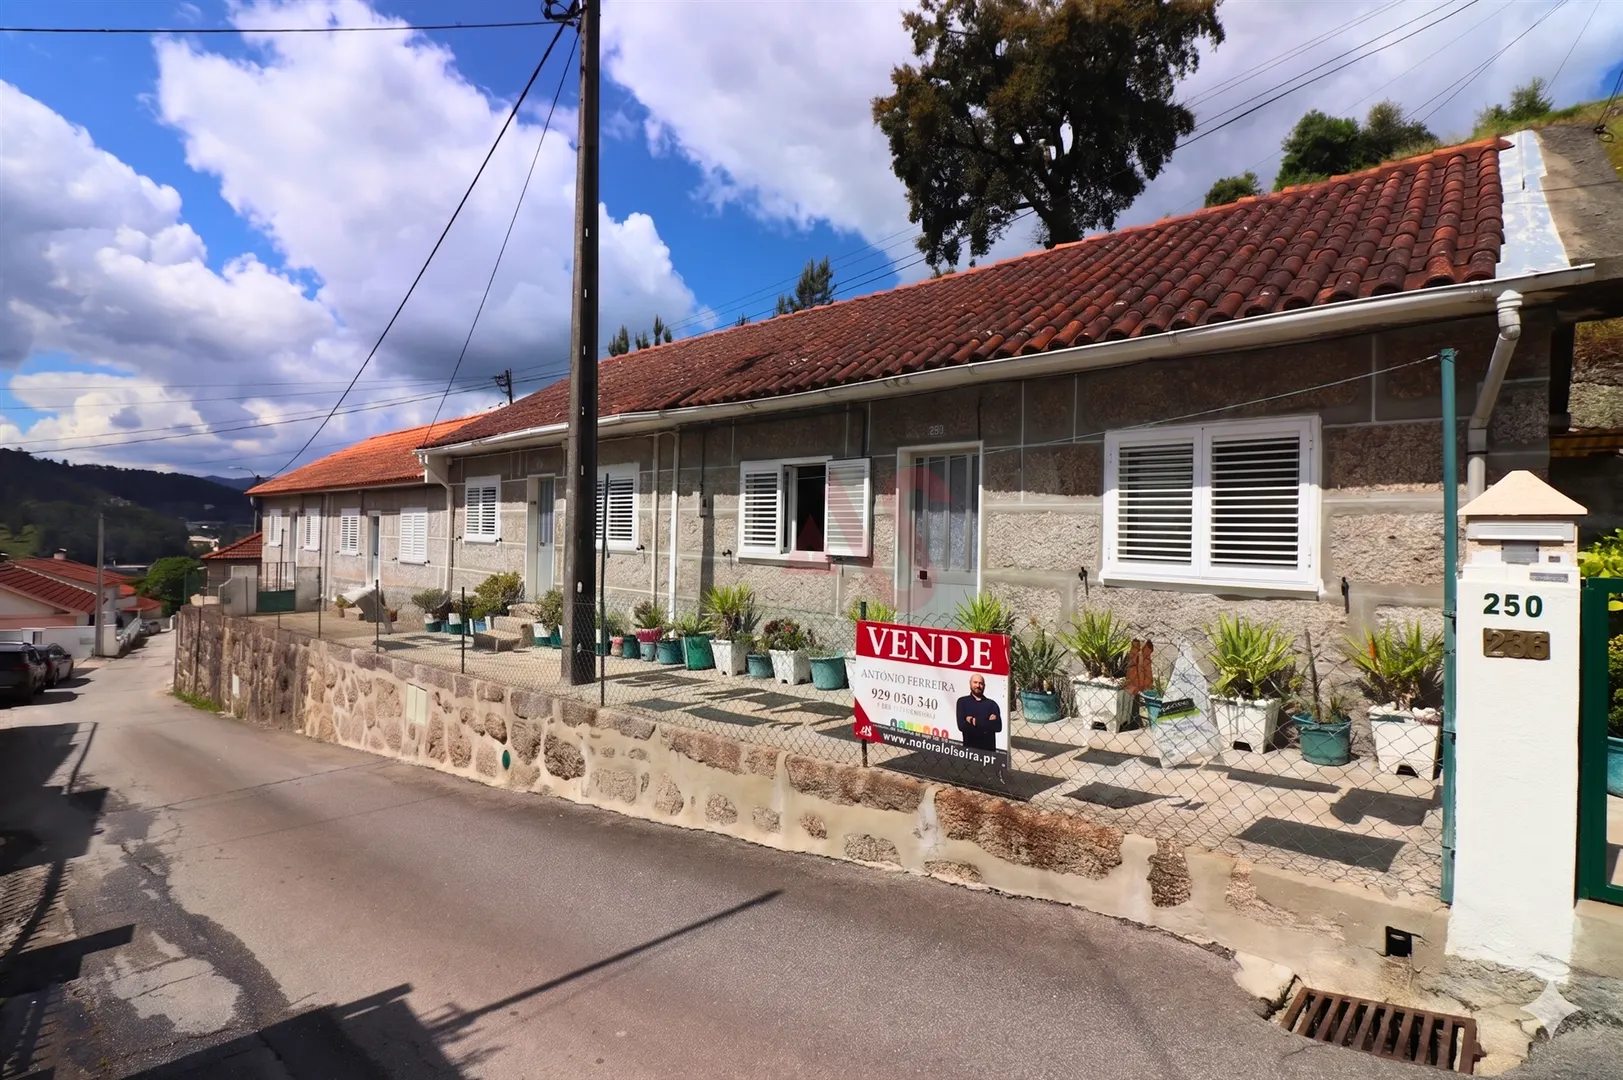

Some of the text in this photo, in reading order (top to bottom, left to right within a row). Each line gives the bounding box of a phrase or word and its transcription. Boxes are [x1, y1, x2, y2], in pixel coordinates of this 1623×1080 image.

[1483, 593, 1543, 618] 250
[866, 626, 993, 670] VENDE
[1485, 629, 1549, 660] 236
[861, 669, 956, 693] ANTÓNIO FERREIRA
[871, 688, 891, 701] 929
[917, 696, 938, 710] 340
